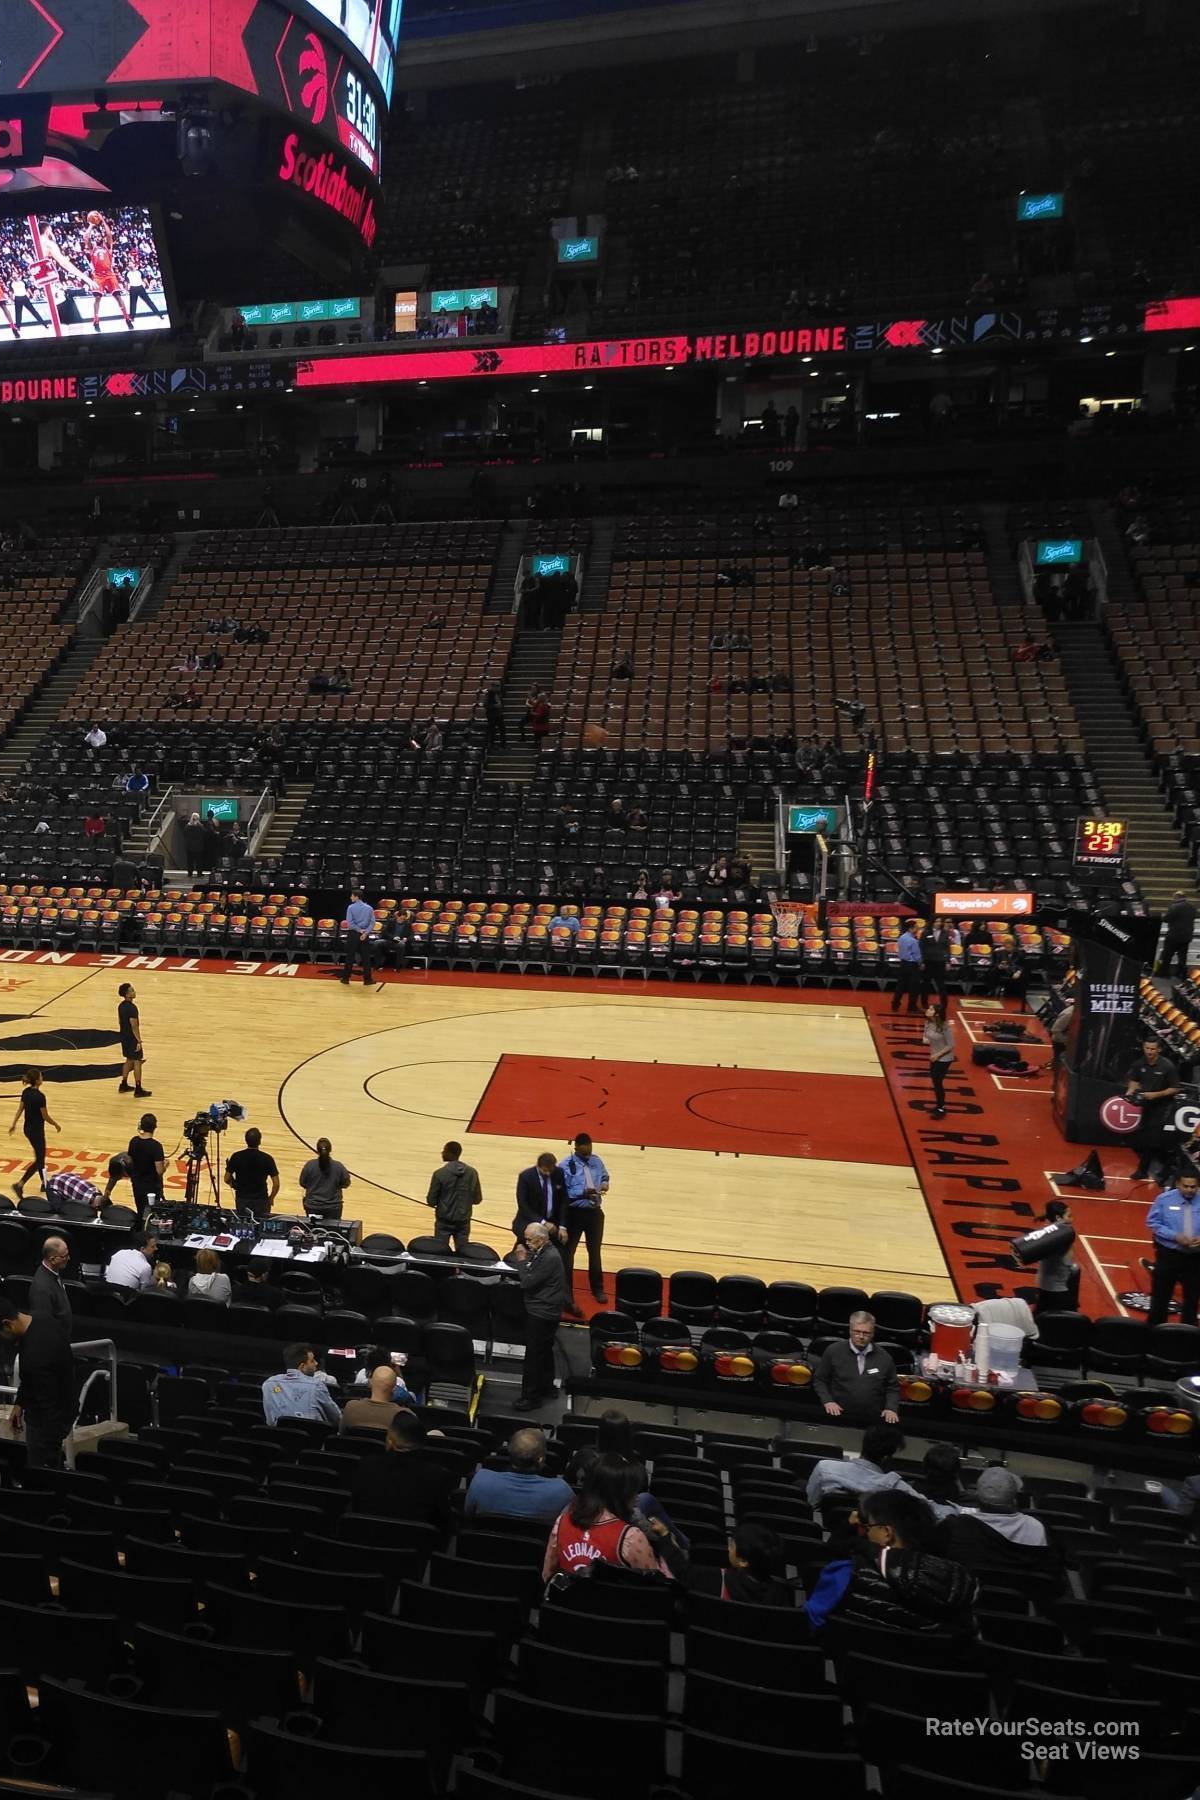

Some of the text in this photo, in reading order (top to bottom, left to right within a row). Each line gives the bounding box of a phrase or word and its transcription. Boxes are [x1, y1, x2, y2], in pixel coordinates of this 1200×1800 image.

[346, 71, 377, 150] 31:30
[695, 326, 847, 360] MELBOURNE
[768, 460, 794, 472] 109
[1043, 541, 1074, 562] Sprite
[539, 557, 563, 575] Sprite
[1087, 835, 1114, 851] 23
[1088, 856, 1122, 864] TISSOT
[940, 898, 999, 910] Tangerine
[1097, 917, 1132, 943] SPALDING
[87, 954, 200, 972] THE
[226, 962, 300, 977] WE
[1089, 983, 1136, 994] RECHARGE
[1090, 999, 1135, 1012] MILK
[1163, 1105, 1200, 1133] G
[561, 1542, 608, 1563] LEONAR
